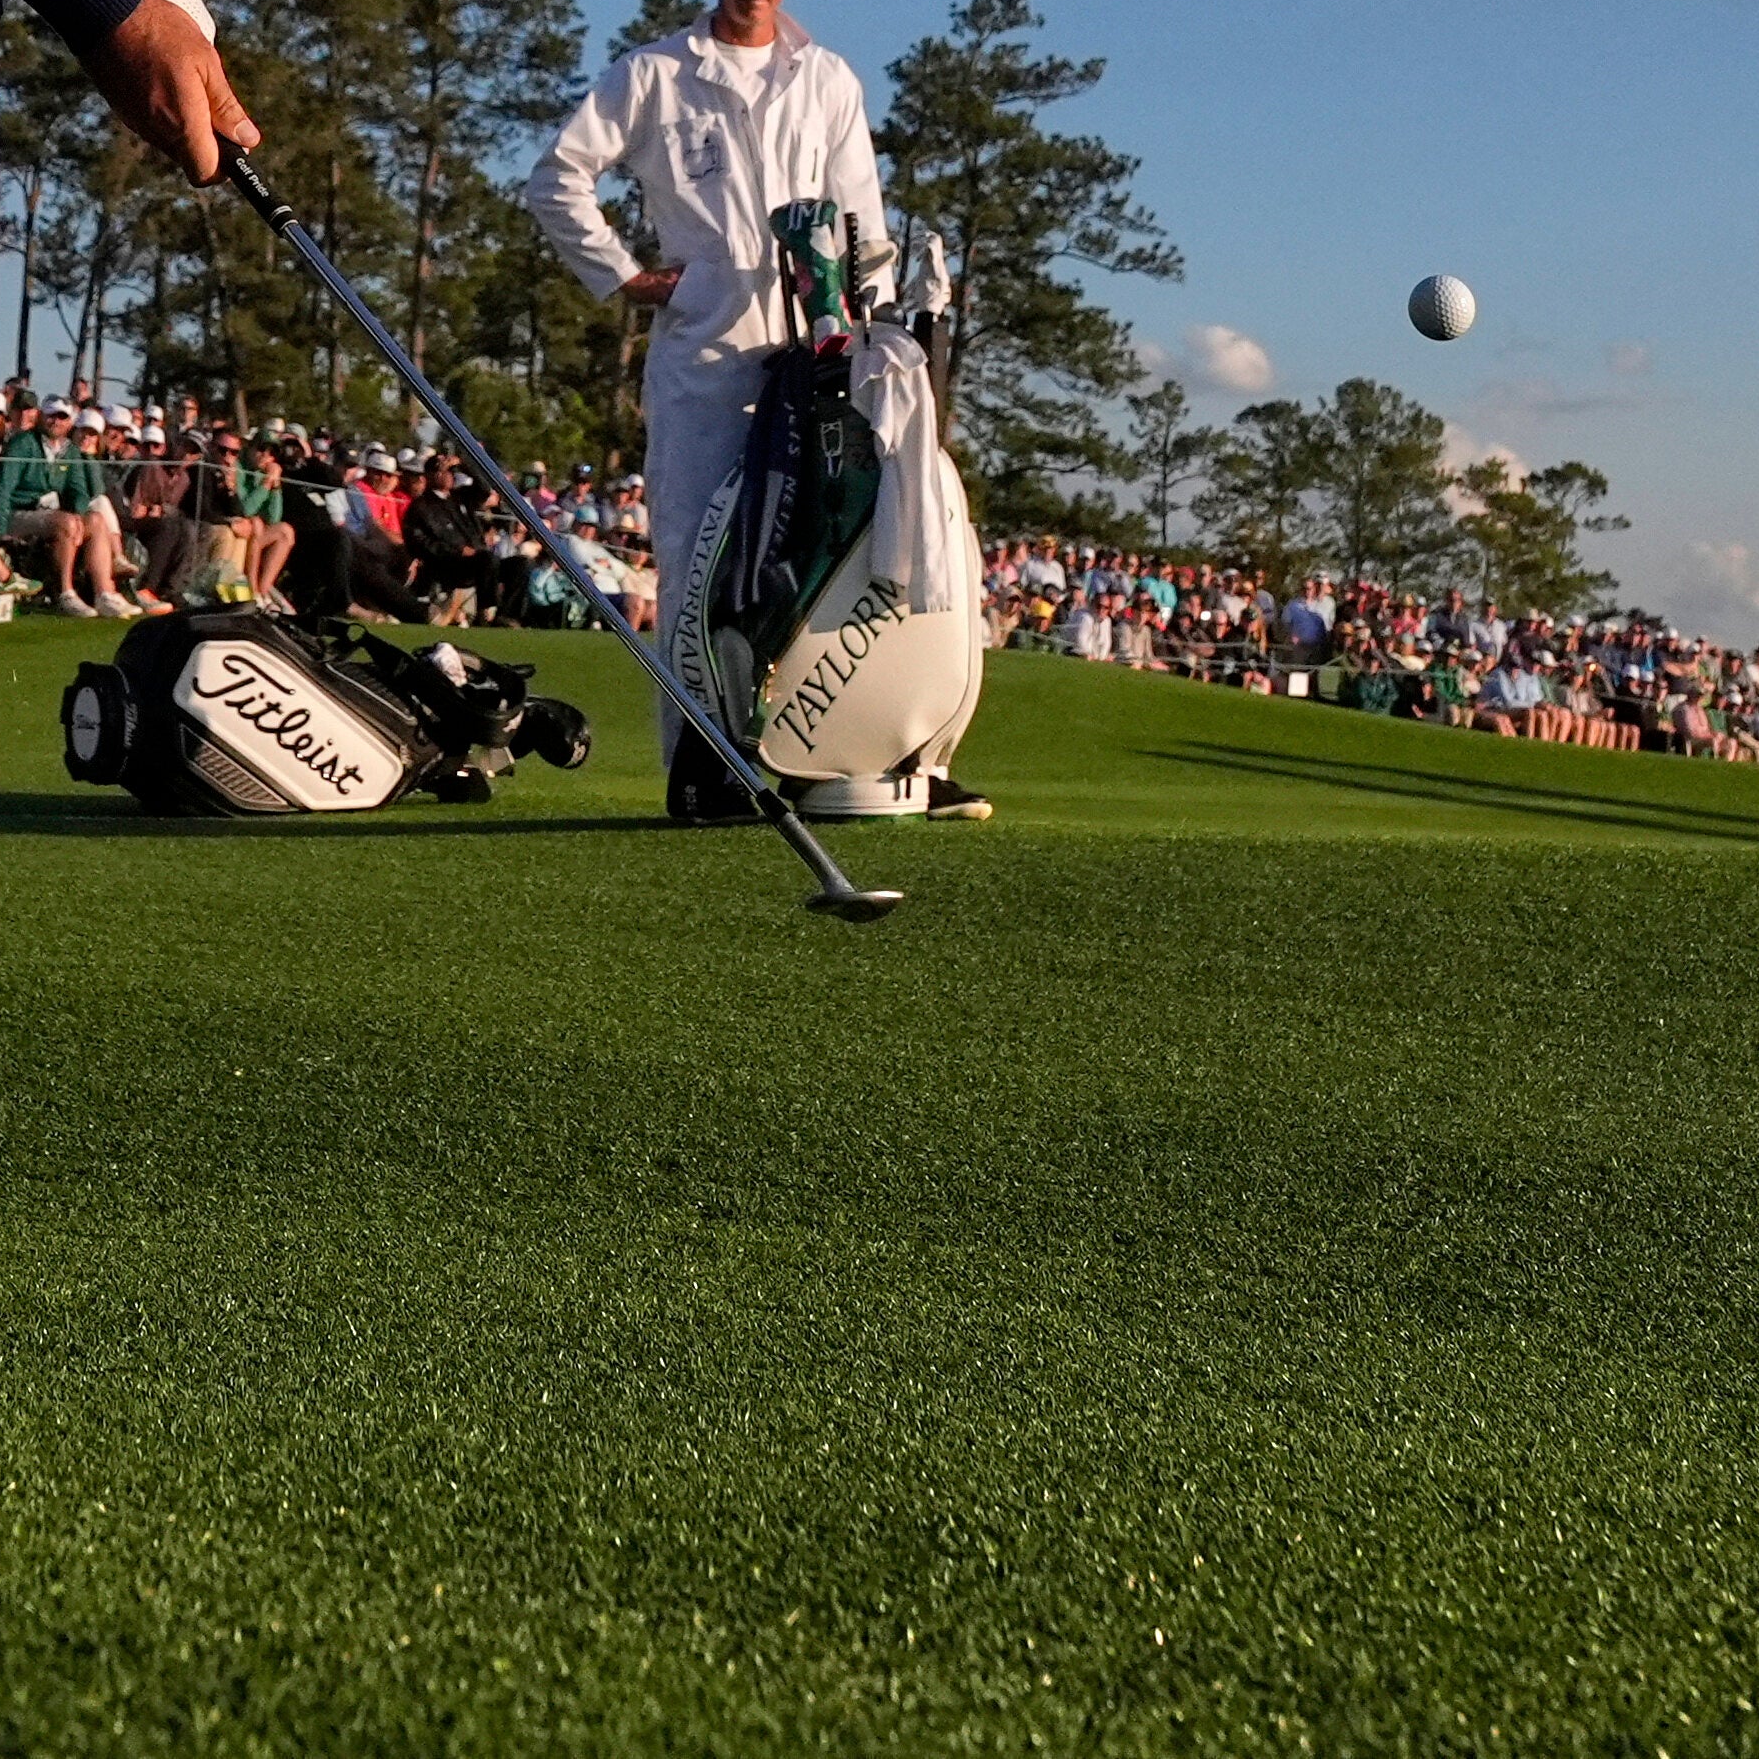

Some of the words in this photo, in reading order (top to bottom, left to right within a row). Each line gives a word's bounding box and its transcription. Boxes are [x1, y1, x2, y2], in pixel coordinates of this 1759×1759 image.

[236, 157, 253, 175] Golf
[248, 174, 269, 197] Pride
[192, 653, 366, 794] Titleist
[772, 578, 906, 754] TAYLORM
